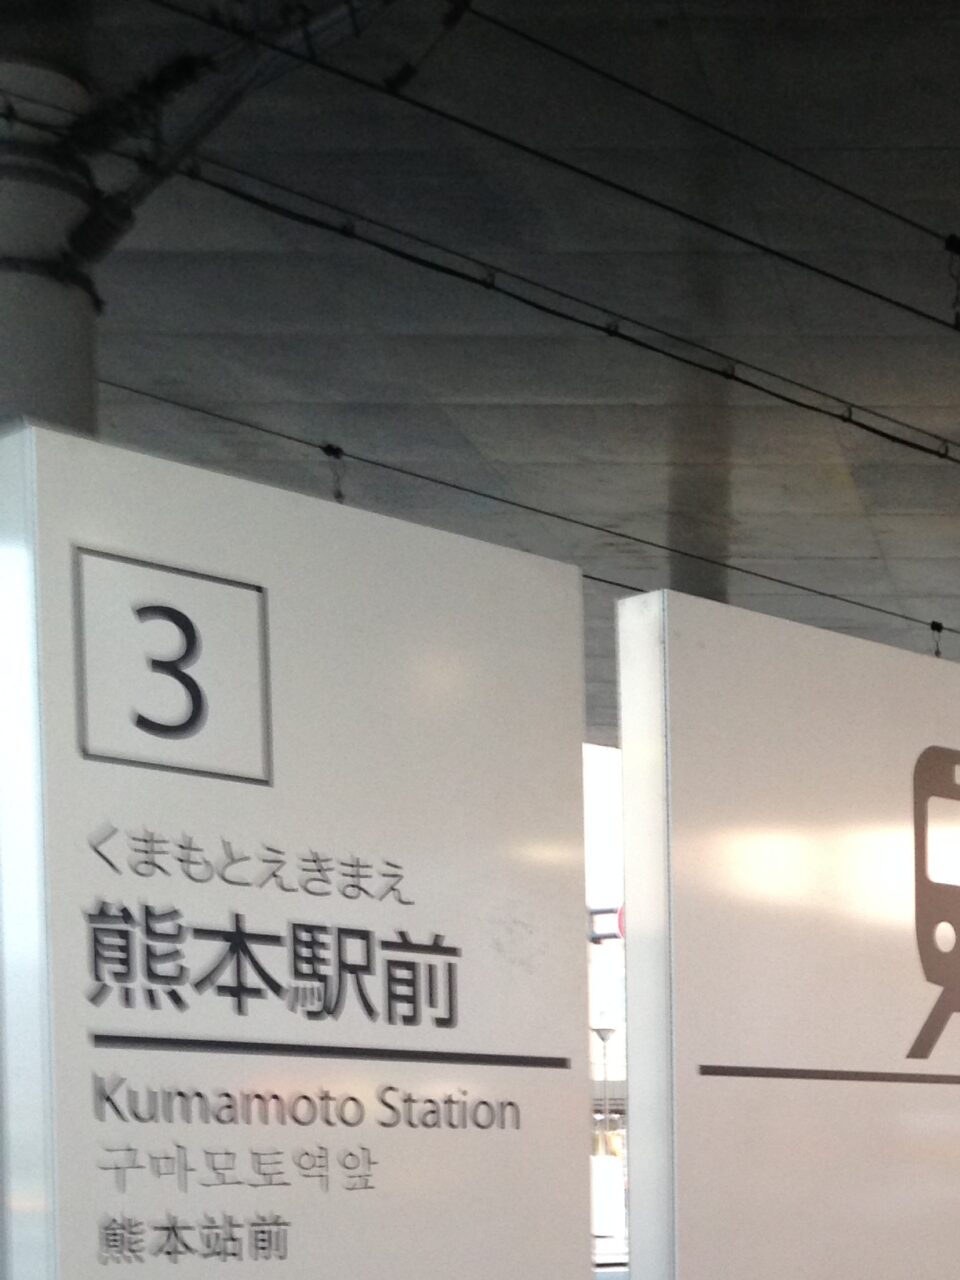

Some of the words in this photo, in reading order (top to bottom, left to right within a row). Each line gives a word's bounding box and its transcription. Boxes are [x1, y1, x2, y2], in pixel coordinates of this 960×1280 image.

[133, 604, 209, 740] 3
[88, 824, 416, 906] くまもとえきまえ
[84, 899, 462, 1030] 熊本駅前
[92, 1072, 366, 1127] Kumamoto
[376, 1086, 521, 1130] Station
[98, 1142, 379, 1195] 구마모토역앞
[99, 1211, 292, 1266] 熊本站前
